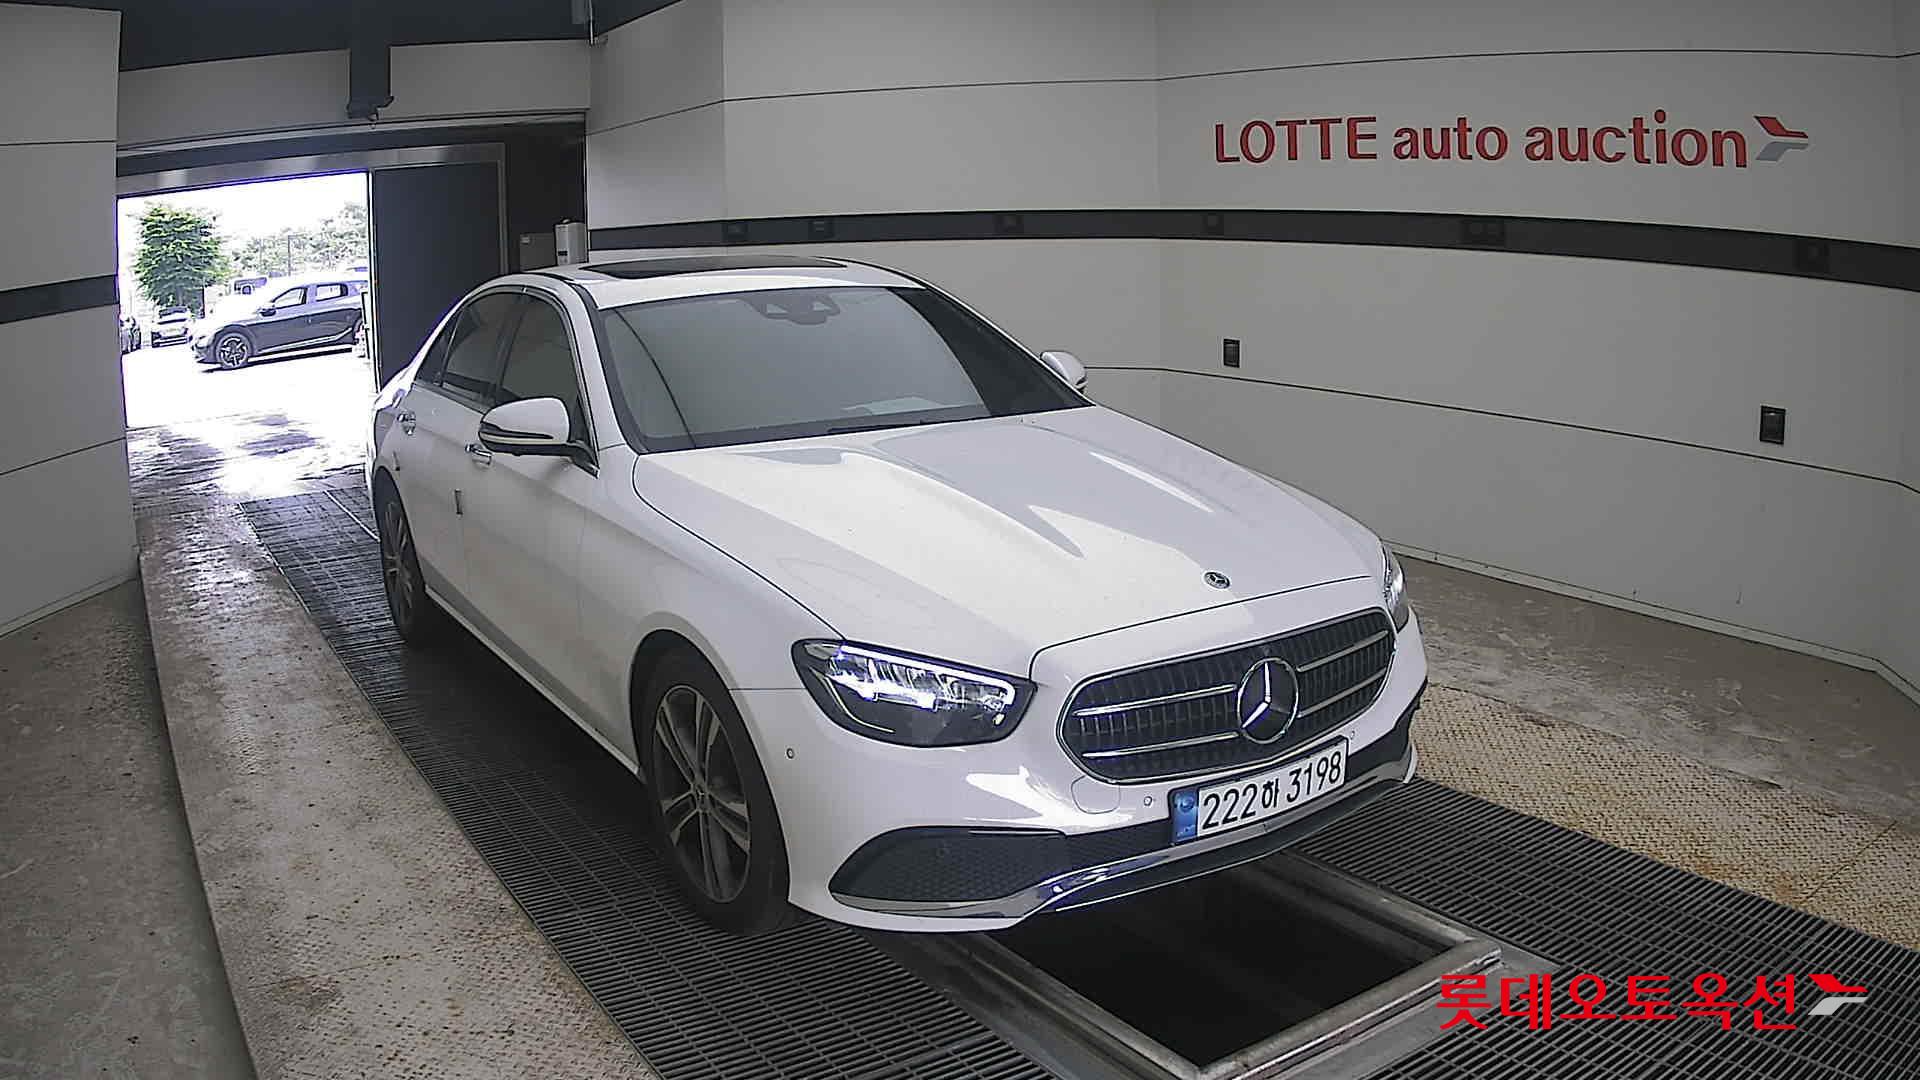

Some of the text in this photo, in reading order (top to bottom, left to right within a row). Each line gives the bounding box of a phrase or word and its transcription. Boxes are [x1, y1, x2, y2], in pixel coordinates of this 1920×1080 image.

[1215, 109, 1748, 168] LOTTE auto auction
[1202, 751, 1343, 830] 222하 3198
